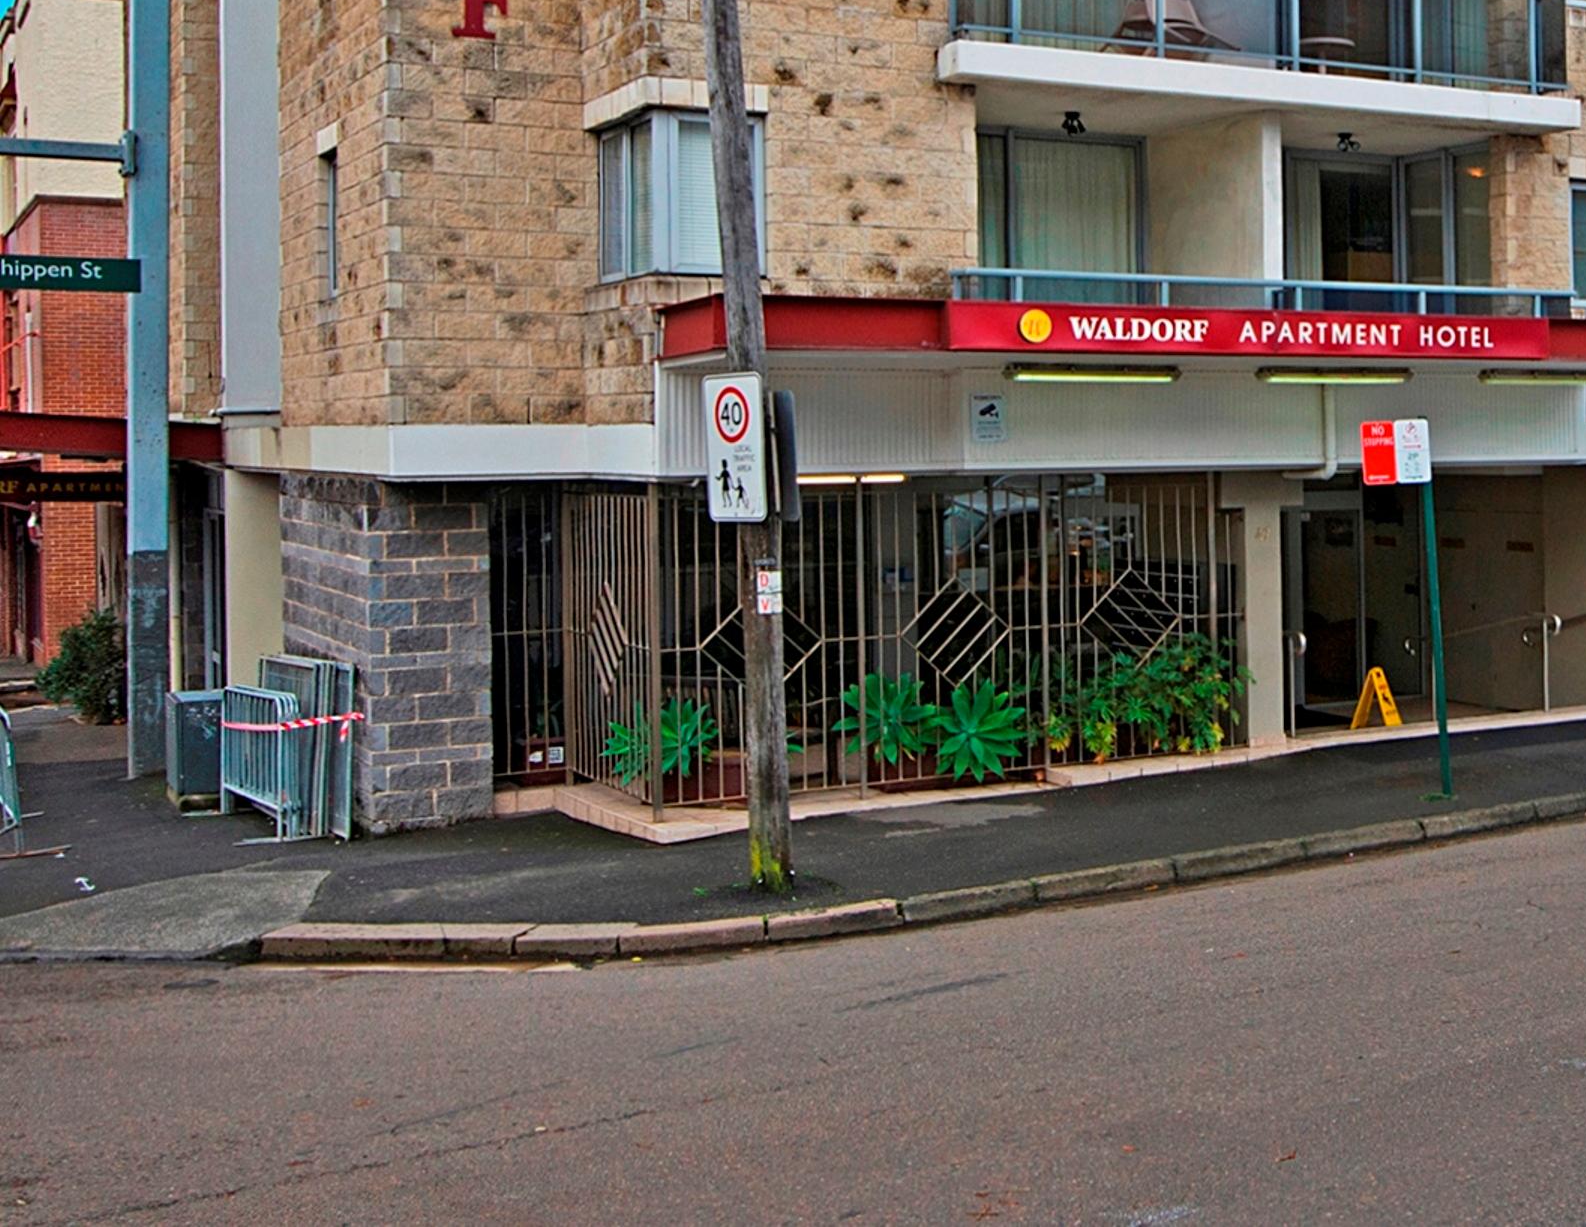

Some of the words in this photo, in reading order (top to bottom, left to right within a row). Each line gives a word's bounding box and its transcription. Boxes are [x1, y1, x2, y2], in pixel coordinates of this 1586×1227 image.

[80, 261, 102, 279] St
[1069, 316, 1209, 342] WALDORF
[1239, 320, 1402, 347] APARTMENT
[1419, 325, 1494, 348] HOTEL
[721, 401, 743, 426] 40
[1371, 425, 1385, 436] NO
